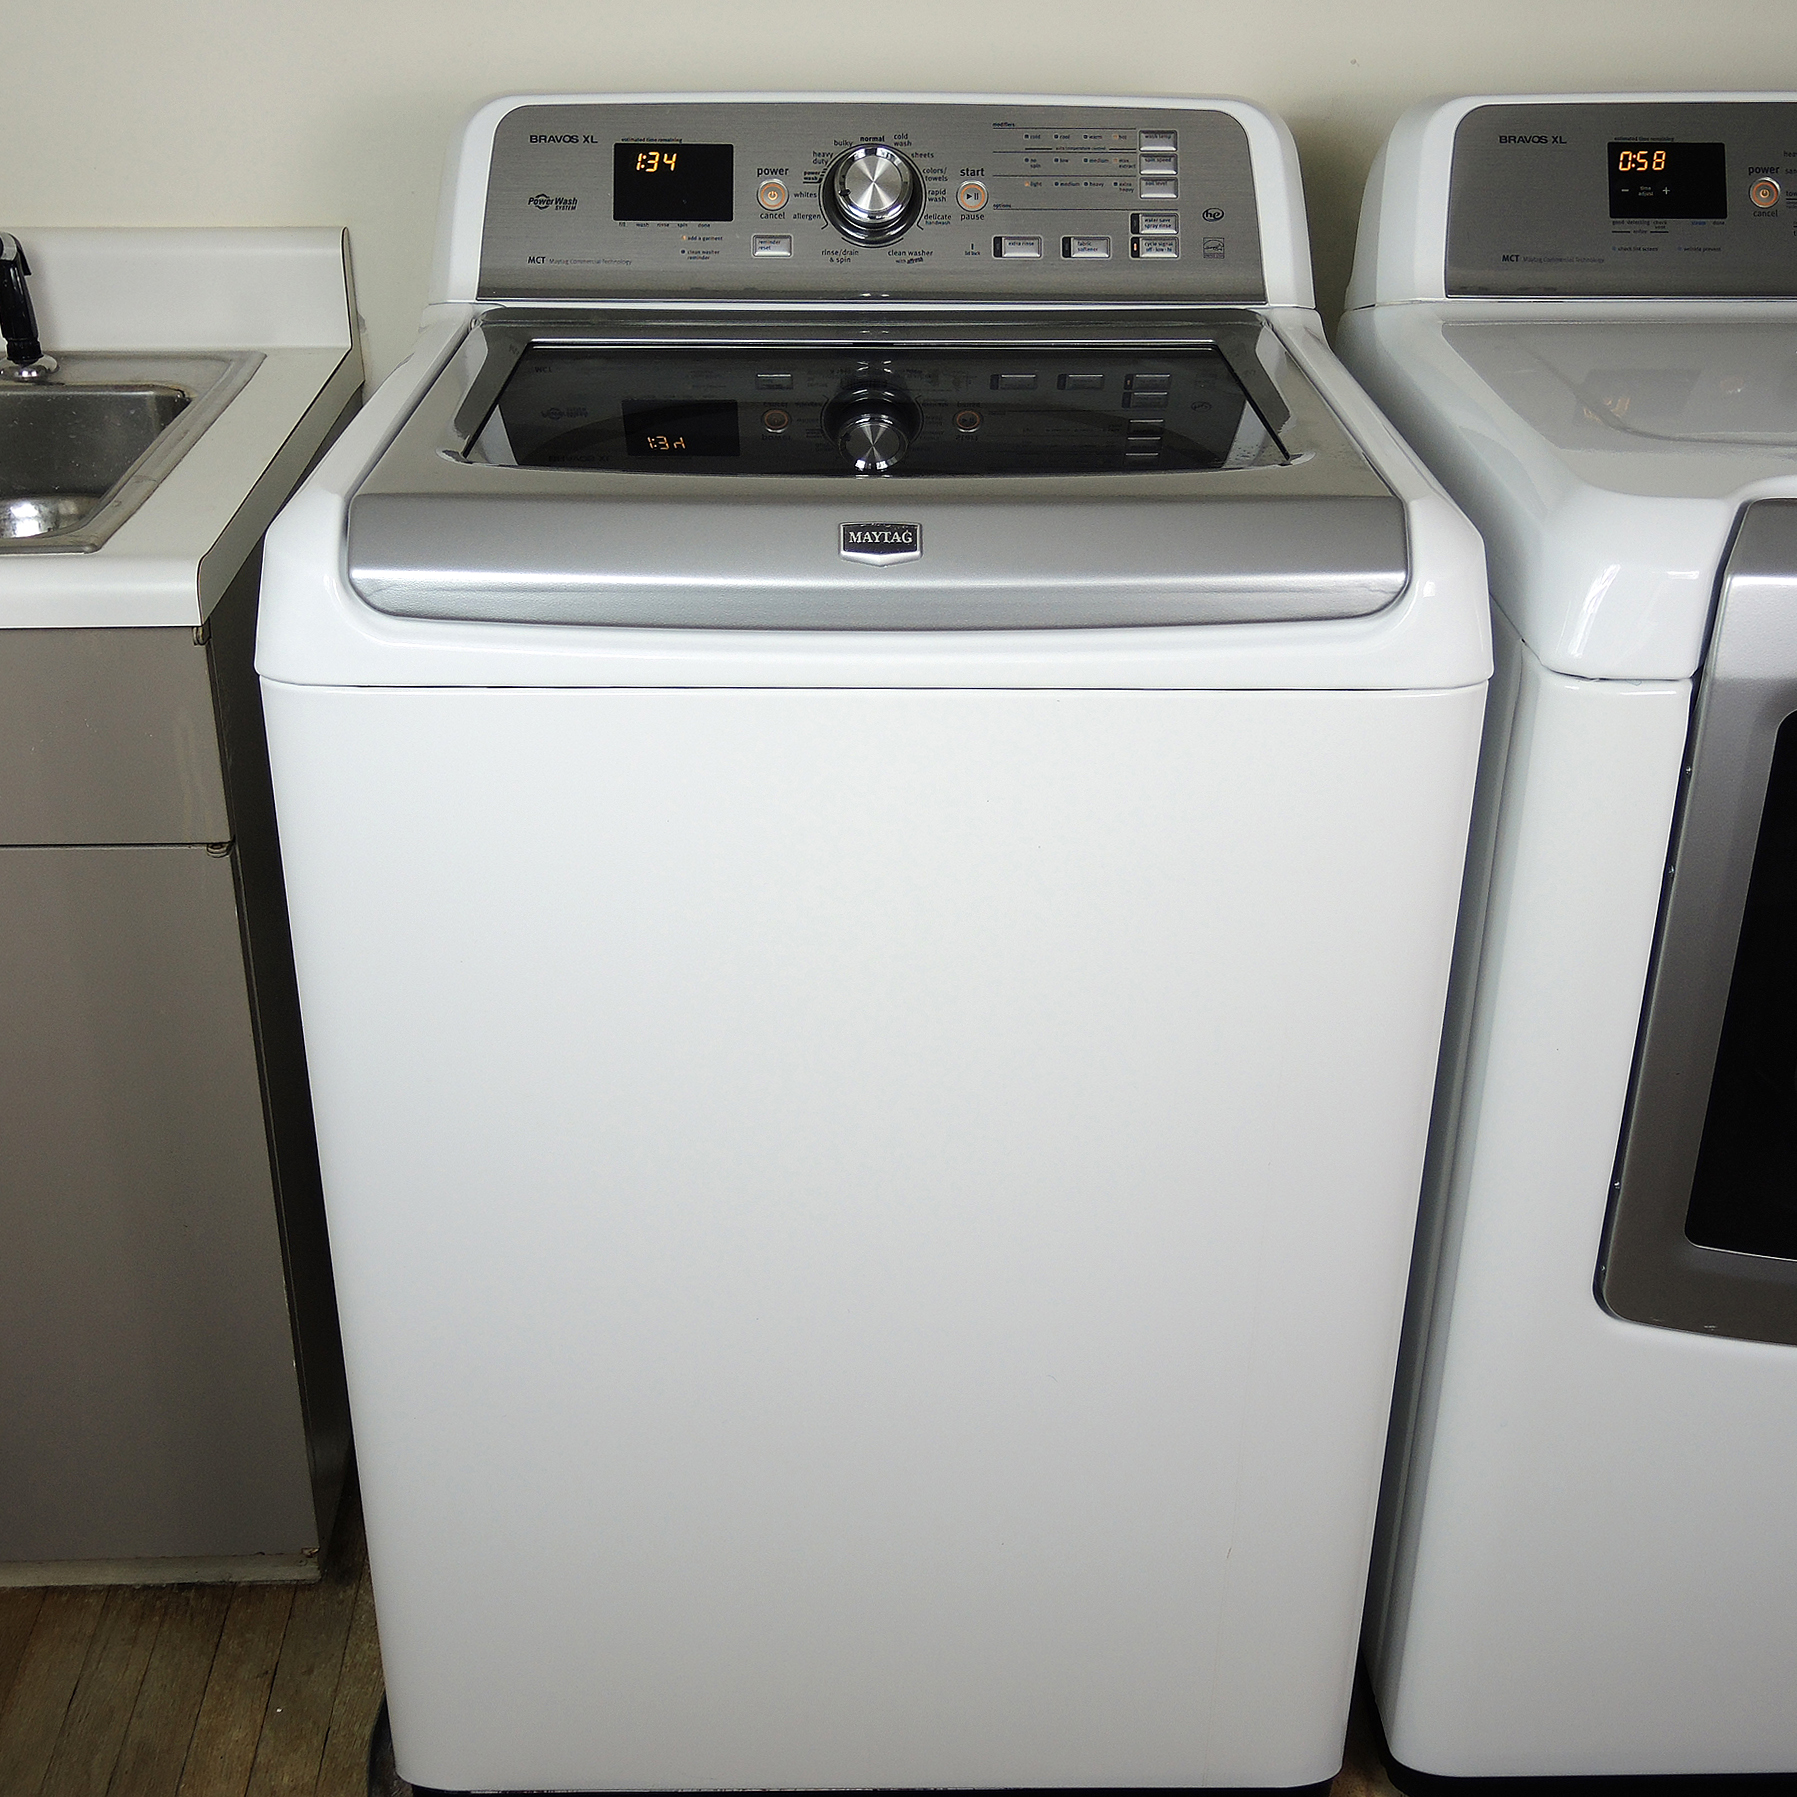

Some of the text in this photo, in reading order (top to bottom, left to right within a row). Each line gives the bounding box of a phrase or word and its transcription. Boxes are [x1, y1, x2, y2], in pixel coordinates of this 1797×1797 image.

[529, 135, 598, 143] BRAVOS XL
[1499, 135, 1567, 144] BRAVOS XL
[636, 151, 677, 172] 1:34
[1619, 151, 1666, 171] 0:58
[757, 167, 789, 177] power
[922, 167, 947, 175] colors/
[960, 168, 985, 177] start
[1748, 166, 1780, 175] power
[528, 196, 578, 206] PowerWash
[528, 256, 546, 264] MCT
[848, 531, 913, 543] MAYTAG
